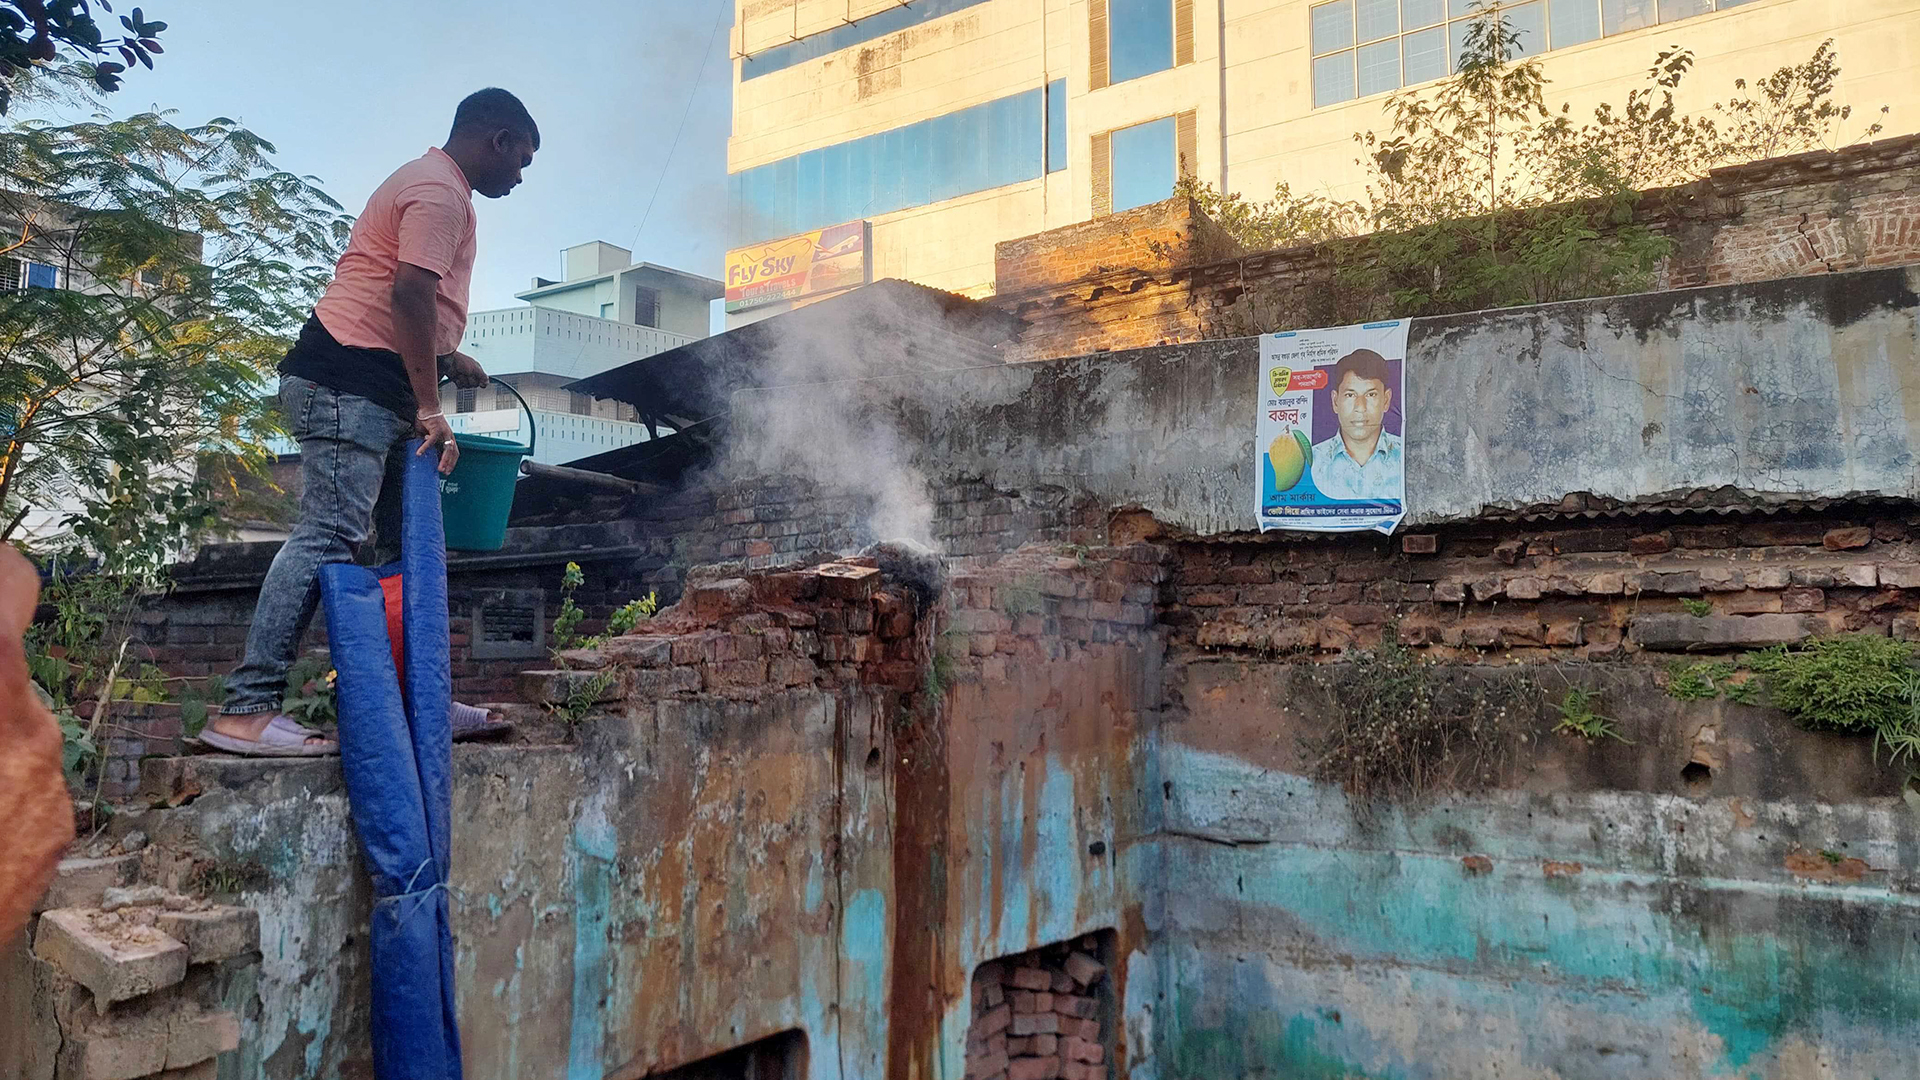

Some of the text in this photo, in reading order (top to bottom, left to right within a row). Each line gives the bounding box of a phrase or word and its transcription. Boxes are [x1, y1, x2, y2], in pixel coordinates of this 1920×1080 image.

[759, 286, 765, 294] &
[739, 289, 796, 307] 01750-222444
[1278, 398, 1295, 407] বজলুর
[1268, 409, 1299, 425] বজলু
[1270, 494, 1287, 502] আম
[1268, 506, 1284, 516] ভোট
